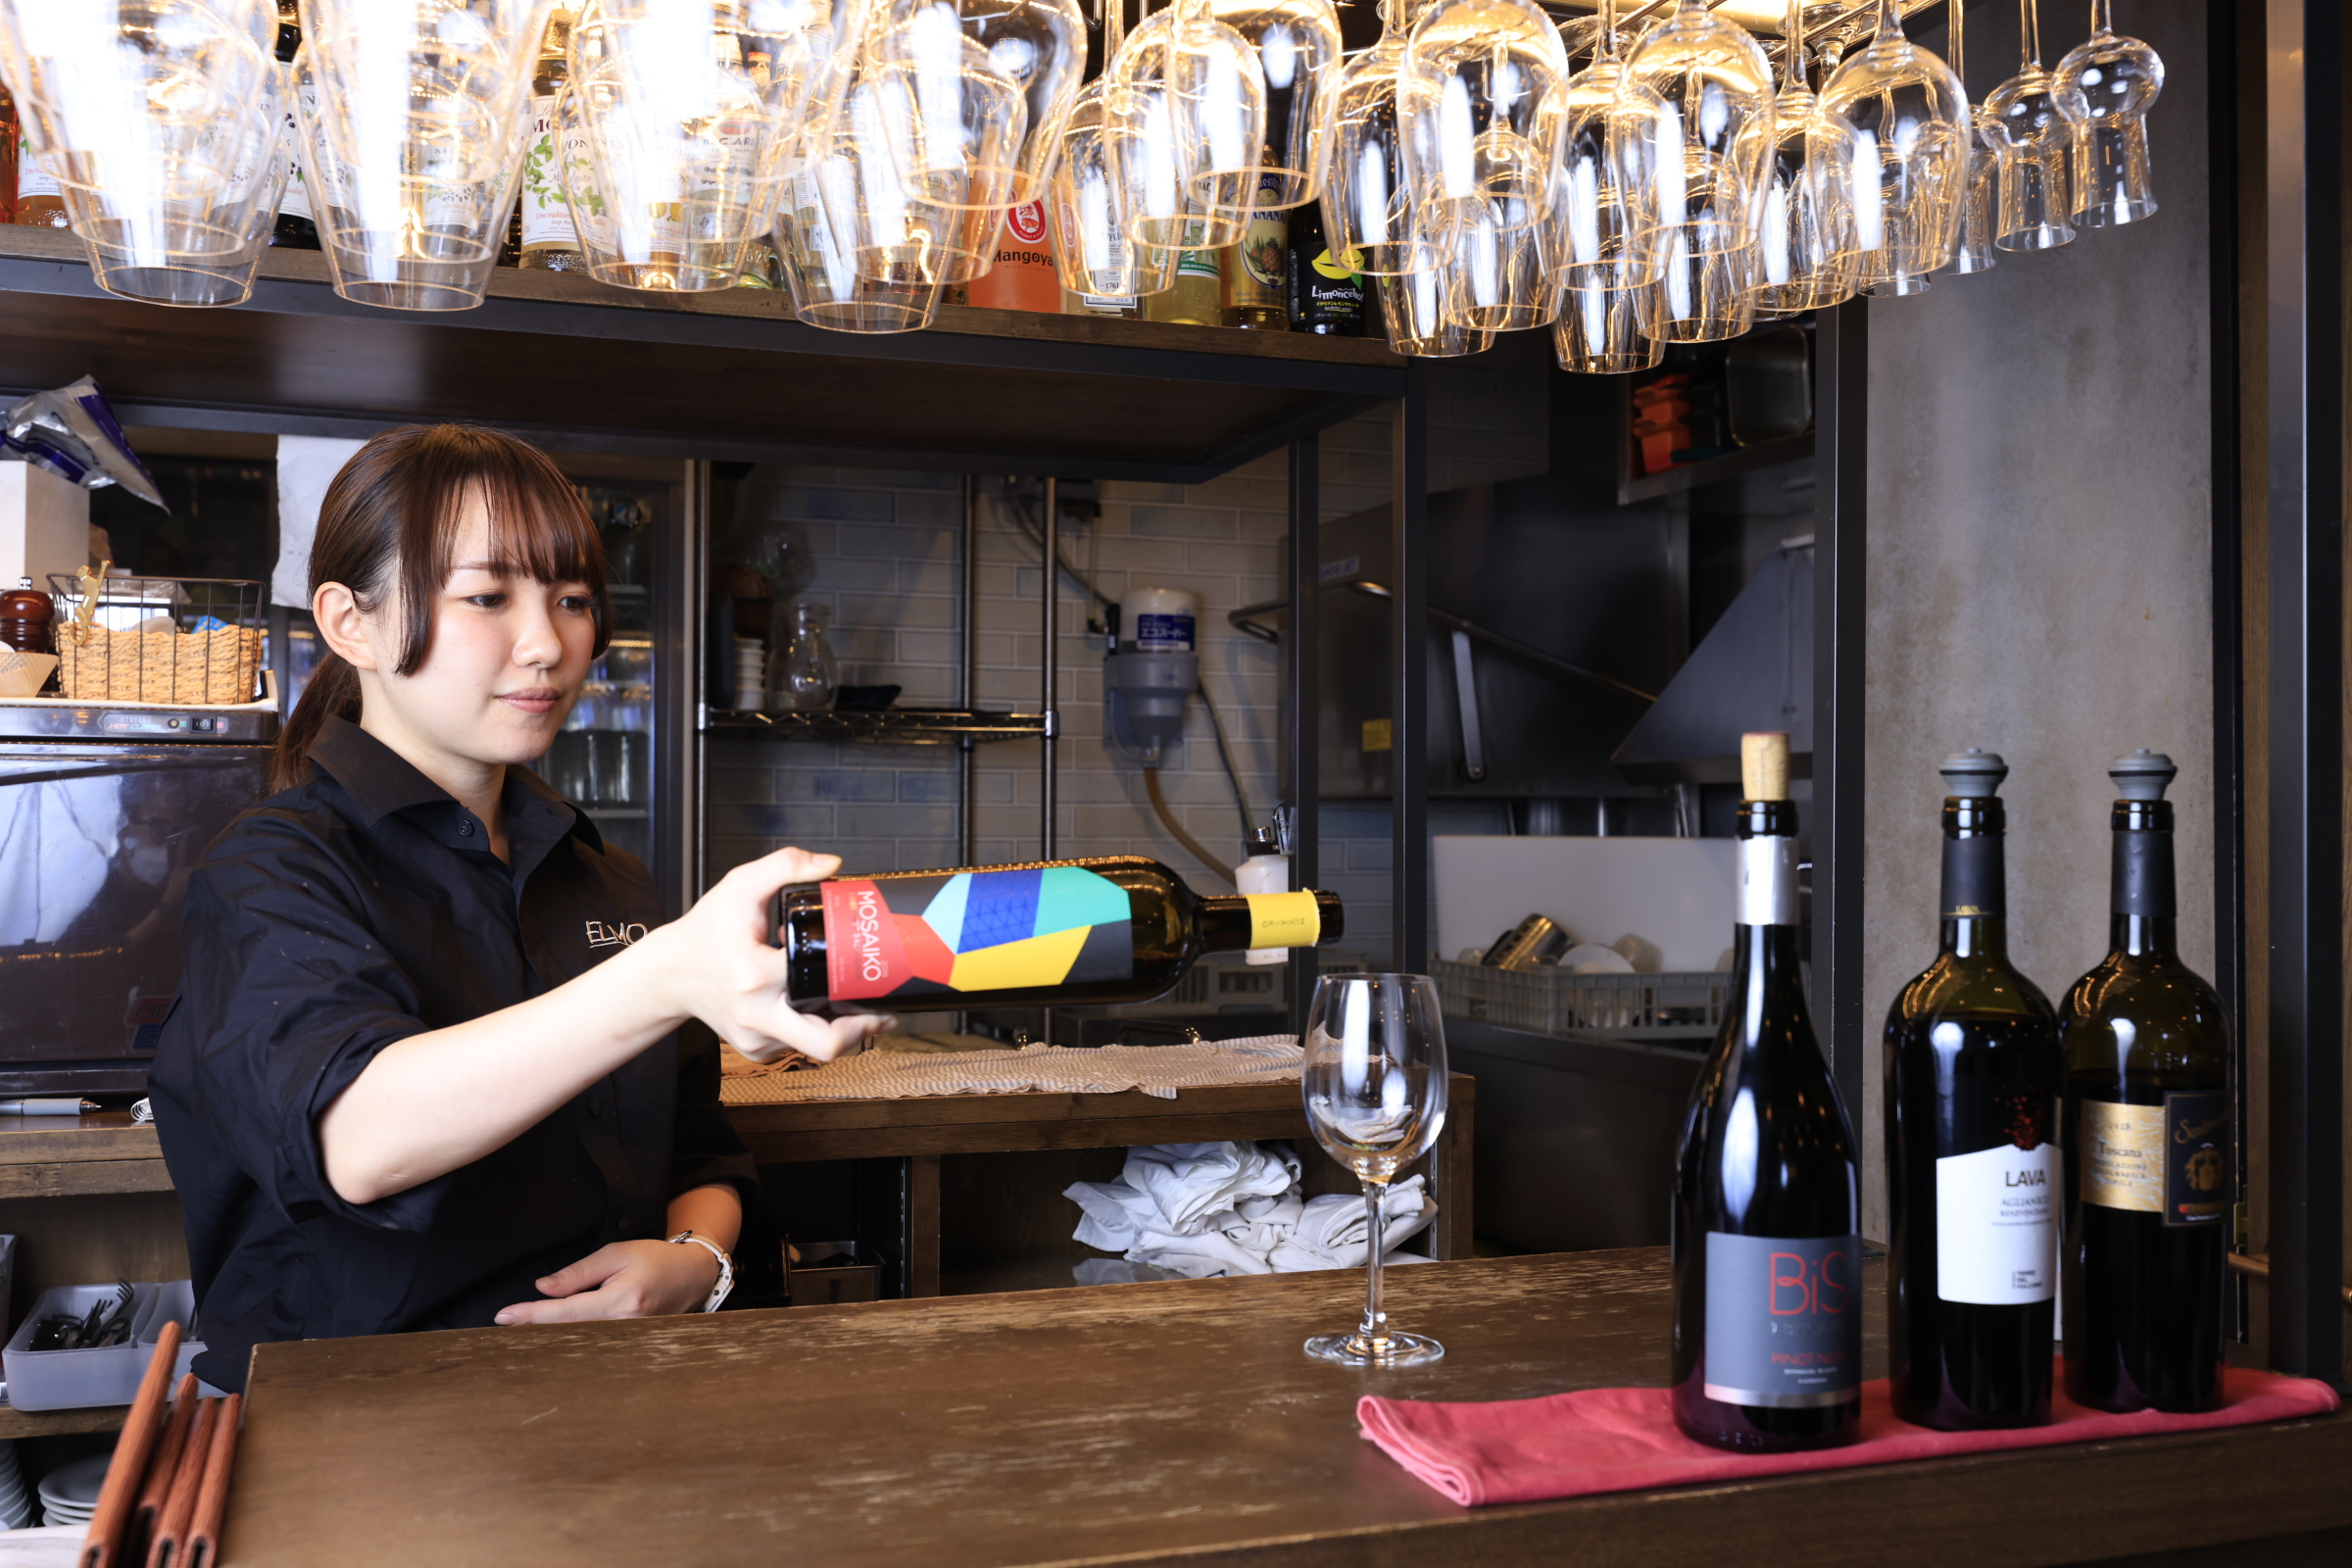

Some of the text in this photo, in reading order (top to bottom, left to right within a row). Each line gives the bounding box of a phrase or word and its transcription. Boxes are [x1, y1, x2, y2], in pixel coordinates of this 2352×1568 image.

[1105, 281, 1119, 290] 1761
[857, 891, 883, 982] MOSAIKO
[2099, 1142, 2142, 1158] Toscana
[2006, 1170, 2047, 1188] LAVA
[1771, 1351, 1813, 1366] PINOT
